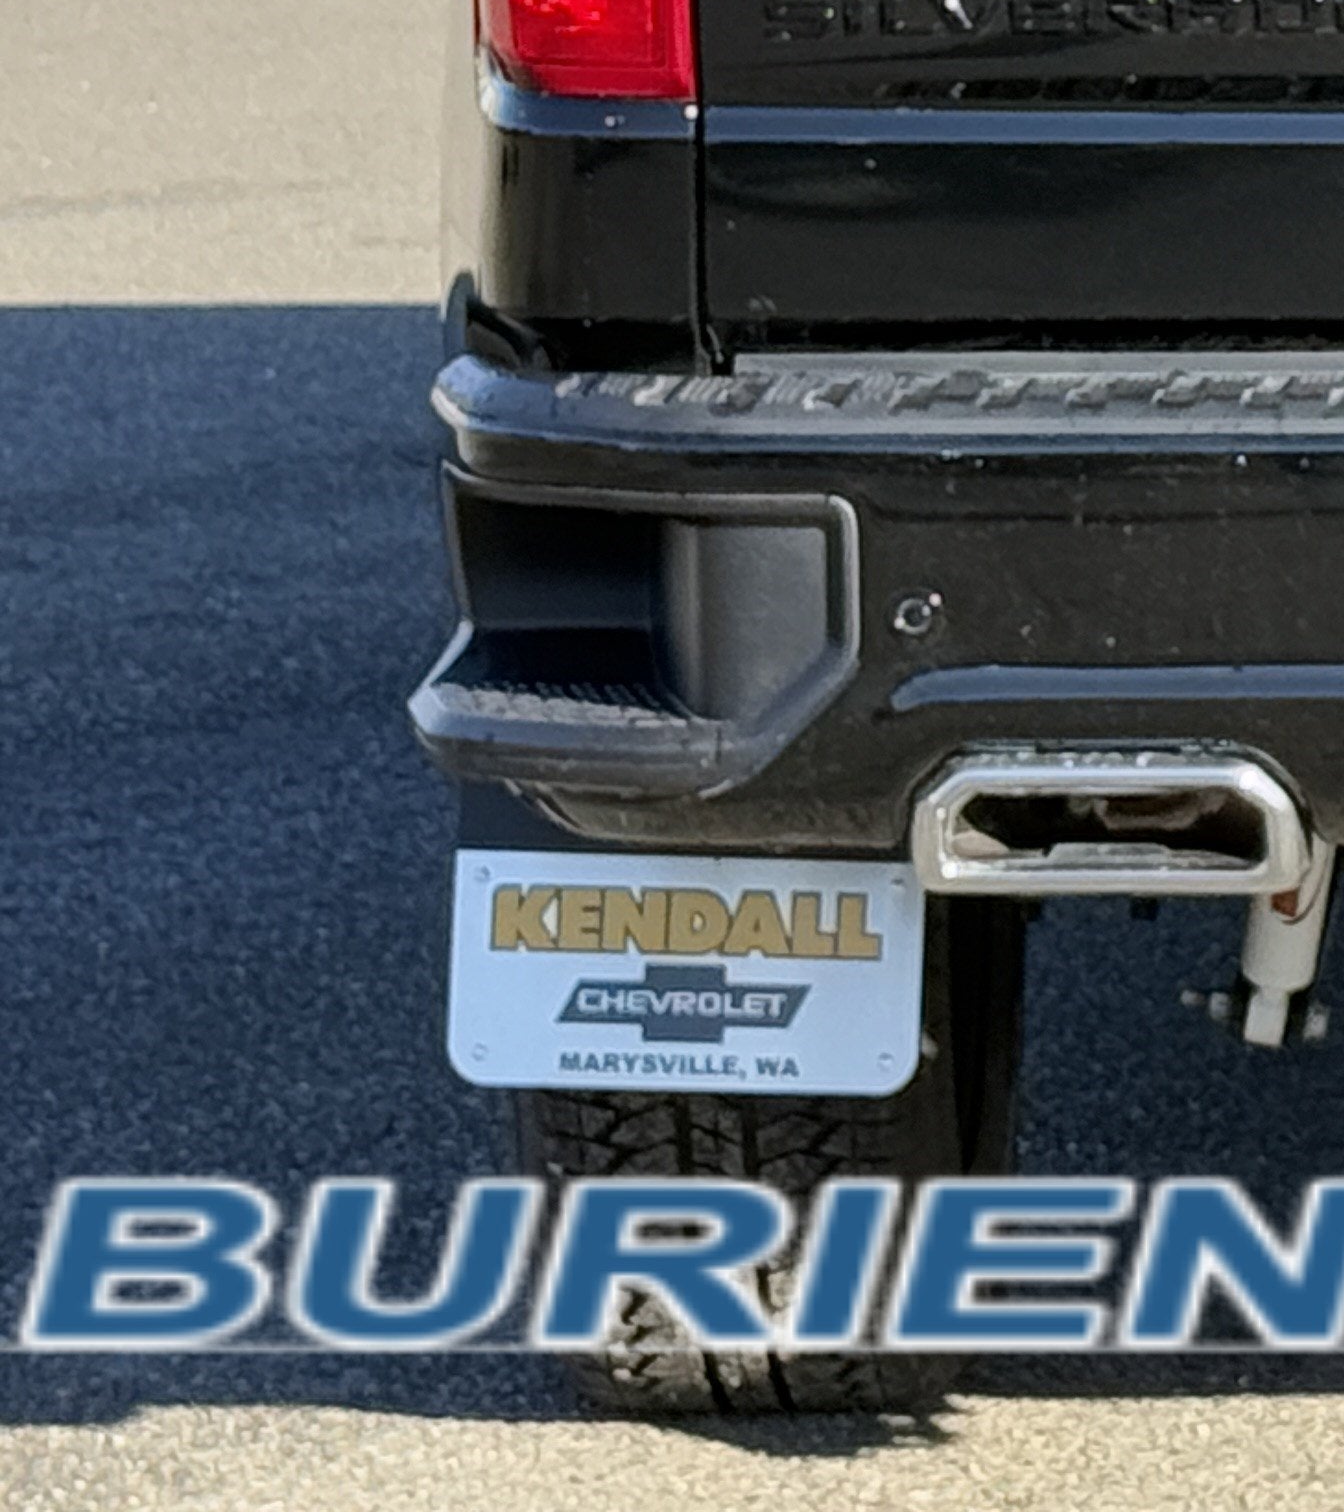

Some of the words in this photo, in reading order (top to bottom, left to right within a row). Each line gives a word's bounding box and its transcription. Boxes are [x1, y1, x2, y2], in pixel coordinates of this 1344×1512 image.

[490, 884, 883, 960] KENDALL
[577, 987, 788, 1018] CHEVROLET
[559, 1052, 747, 1080] MARYSVILLE,
[756, 1058, 800, 1079] WA
